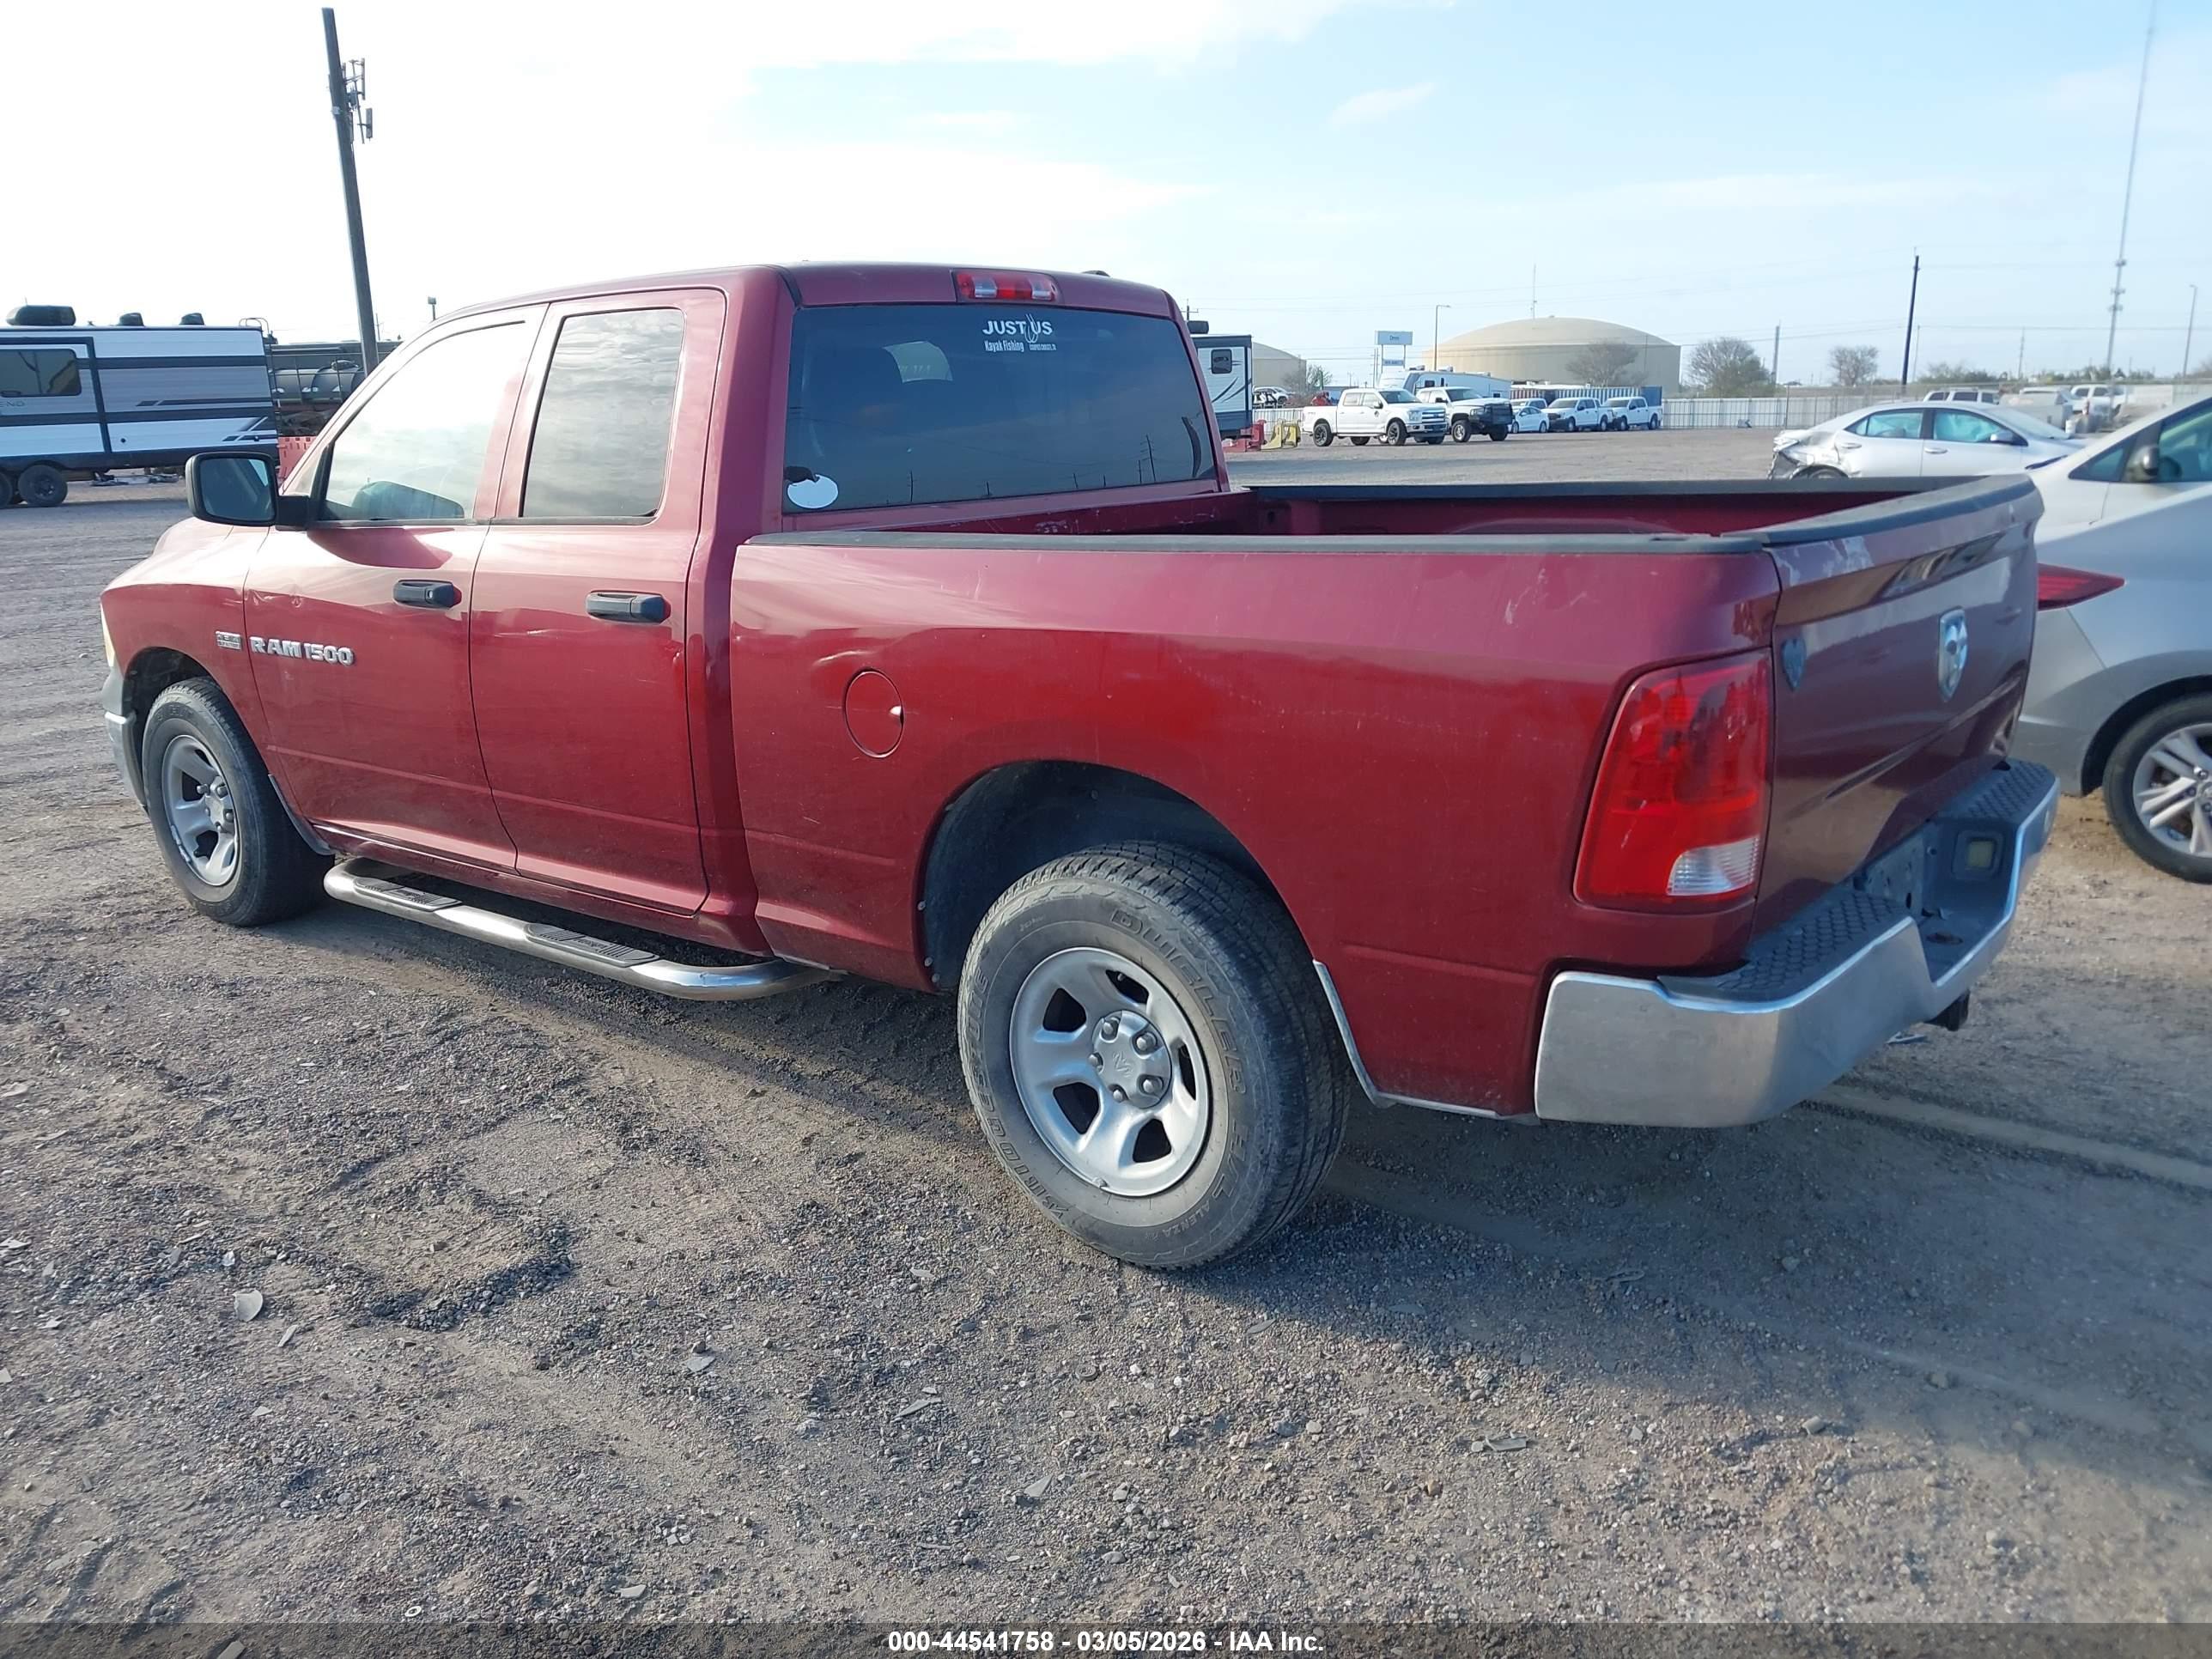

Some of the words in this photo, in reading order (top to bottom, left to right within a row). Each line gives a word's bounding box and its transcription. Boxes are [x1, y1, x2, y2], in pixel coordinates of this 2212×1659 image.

[982, 320, 1026, 335] JUST
[1030, 320, 1053, 335] US
[984, 340, 1003, 352] Kayak
[1003, 340, 1024, 352] Fishing
[249, 635, 302, 659] RAM
[304, 643, 355, 665] 1500
[1110, 909, 1246, 1094] DUELER
[1162, 1200, 1211, 1237] ALENZA
